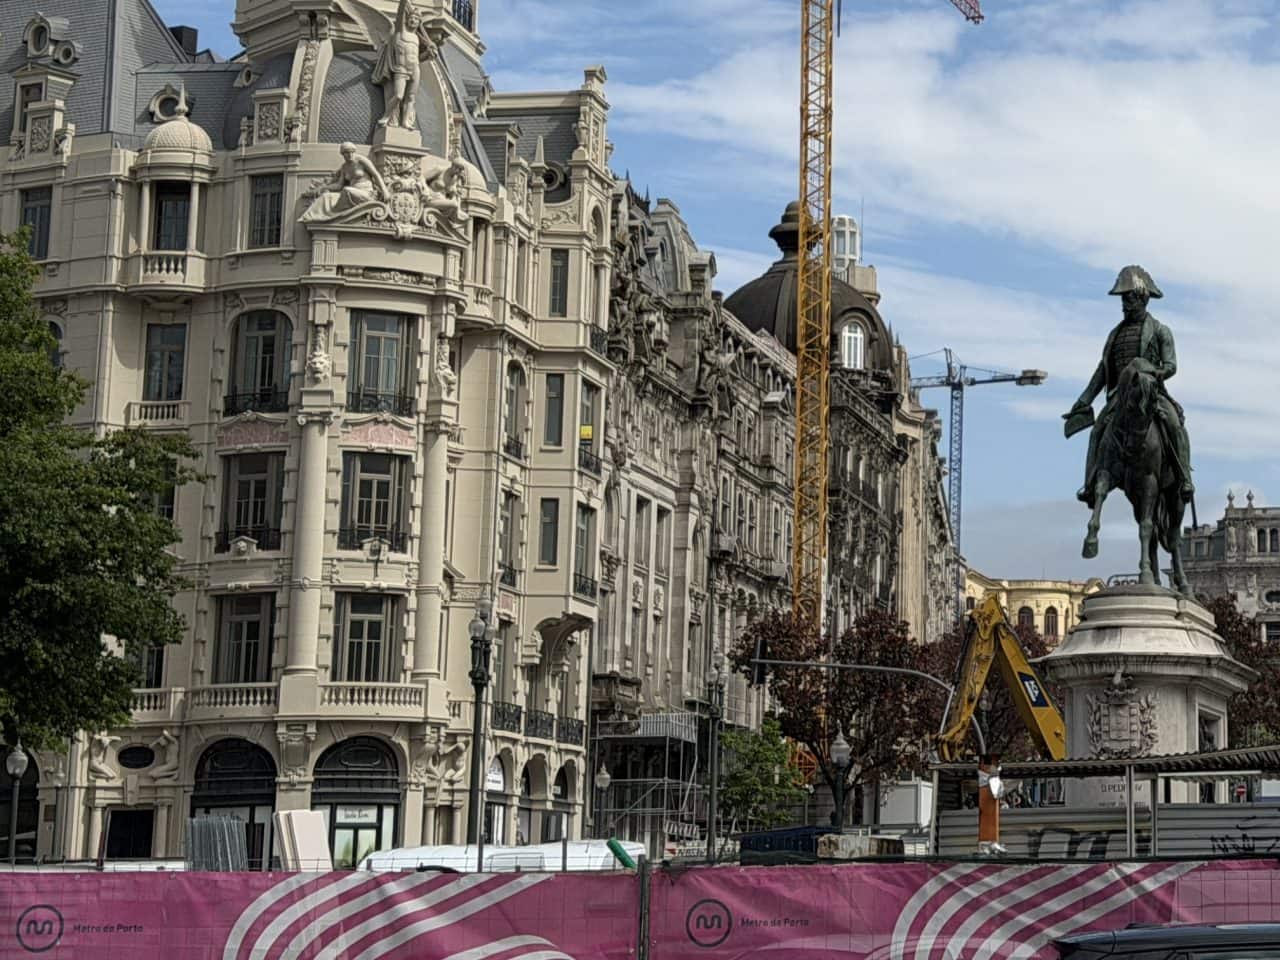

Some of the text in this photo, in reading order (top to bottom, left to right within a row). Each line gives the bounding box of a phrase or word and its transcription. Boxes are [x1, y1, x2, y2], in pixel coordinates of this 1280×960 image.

[740, 918, 768, 927] Metro
[784, 918, 810, 927] Porto
[73, 924, 101, 933] Metro
[117, 923, 143, 932] Porto
